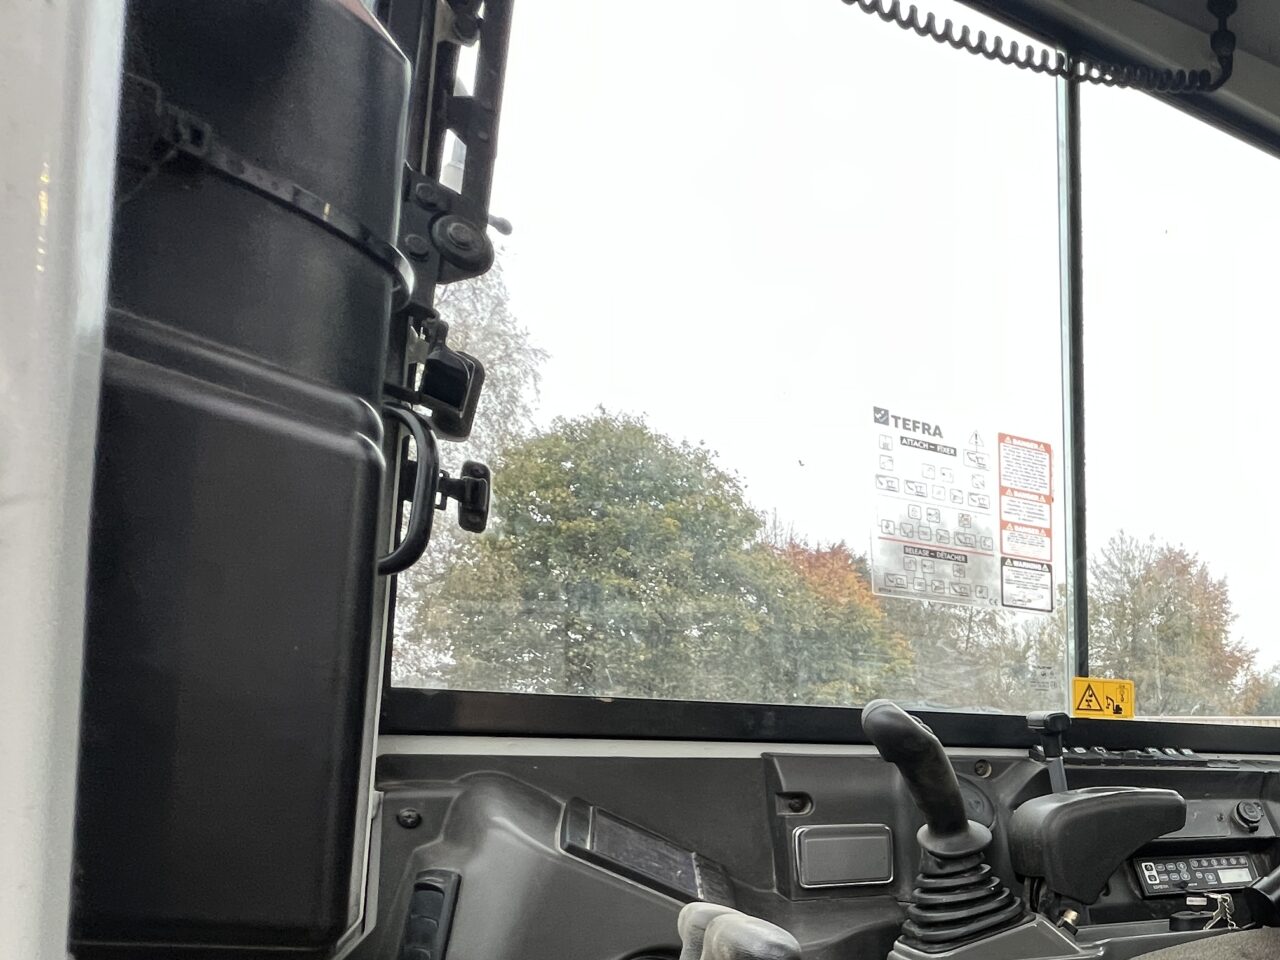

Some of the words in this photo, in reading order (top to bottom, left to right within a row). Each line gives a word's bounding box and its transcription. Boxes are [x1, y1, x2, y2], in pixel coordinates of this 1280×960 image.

[891, 414, 943, 438] TEFRA
[901, 437, 928, 450] ATTACH
[936, 444, 955, 456] FIXER
[905, 547, 929, 557] RELEASE
